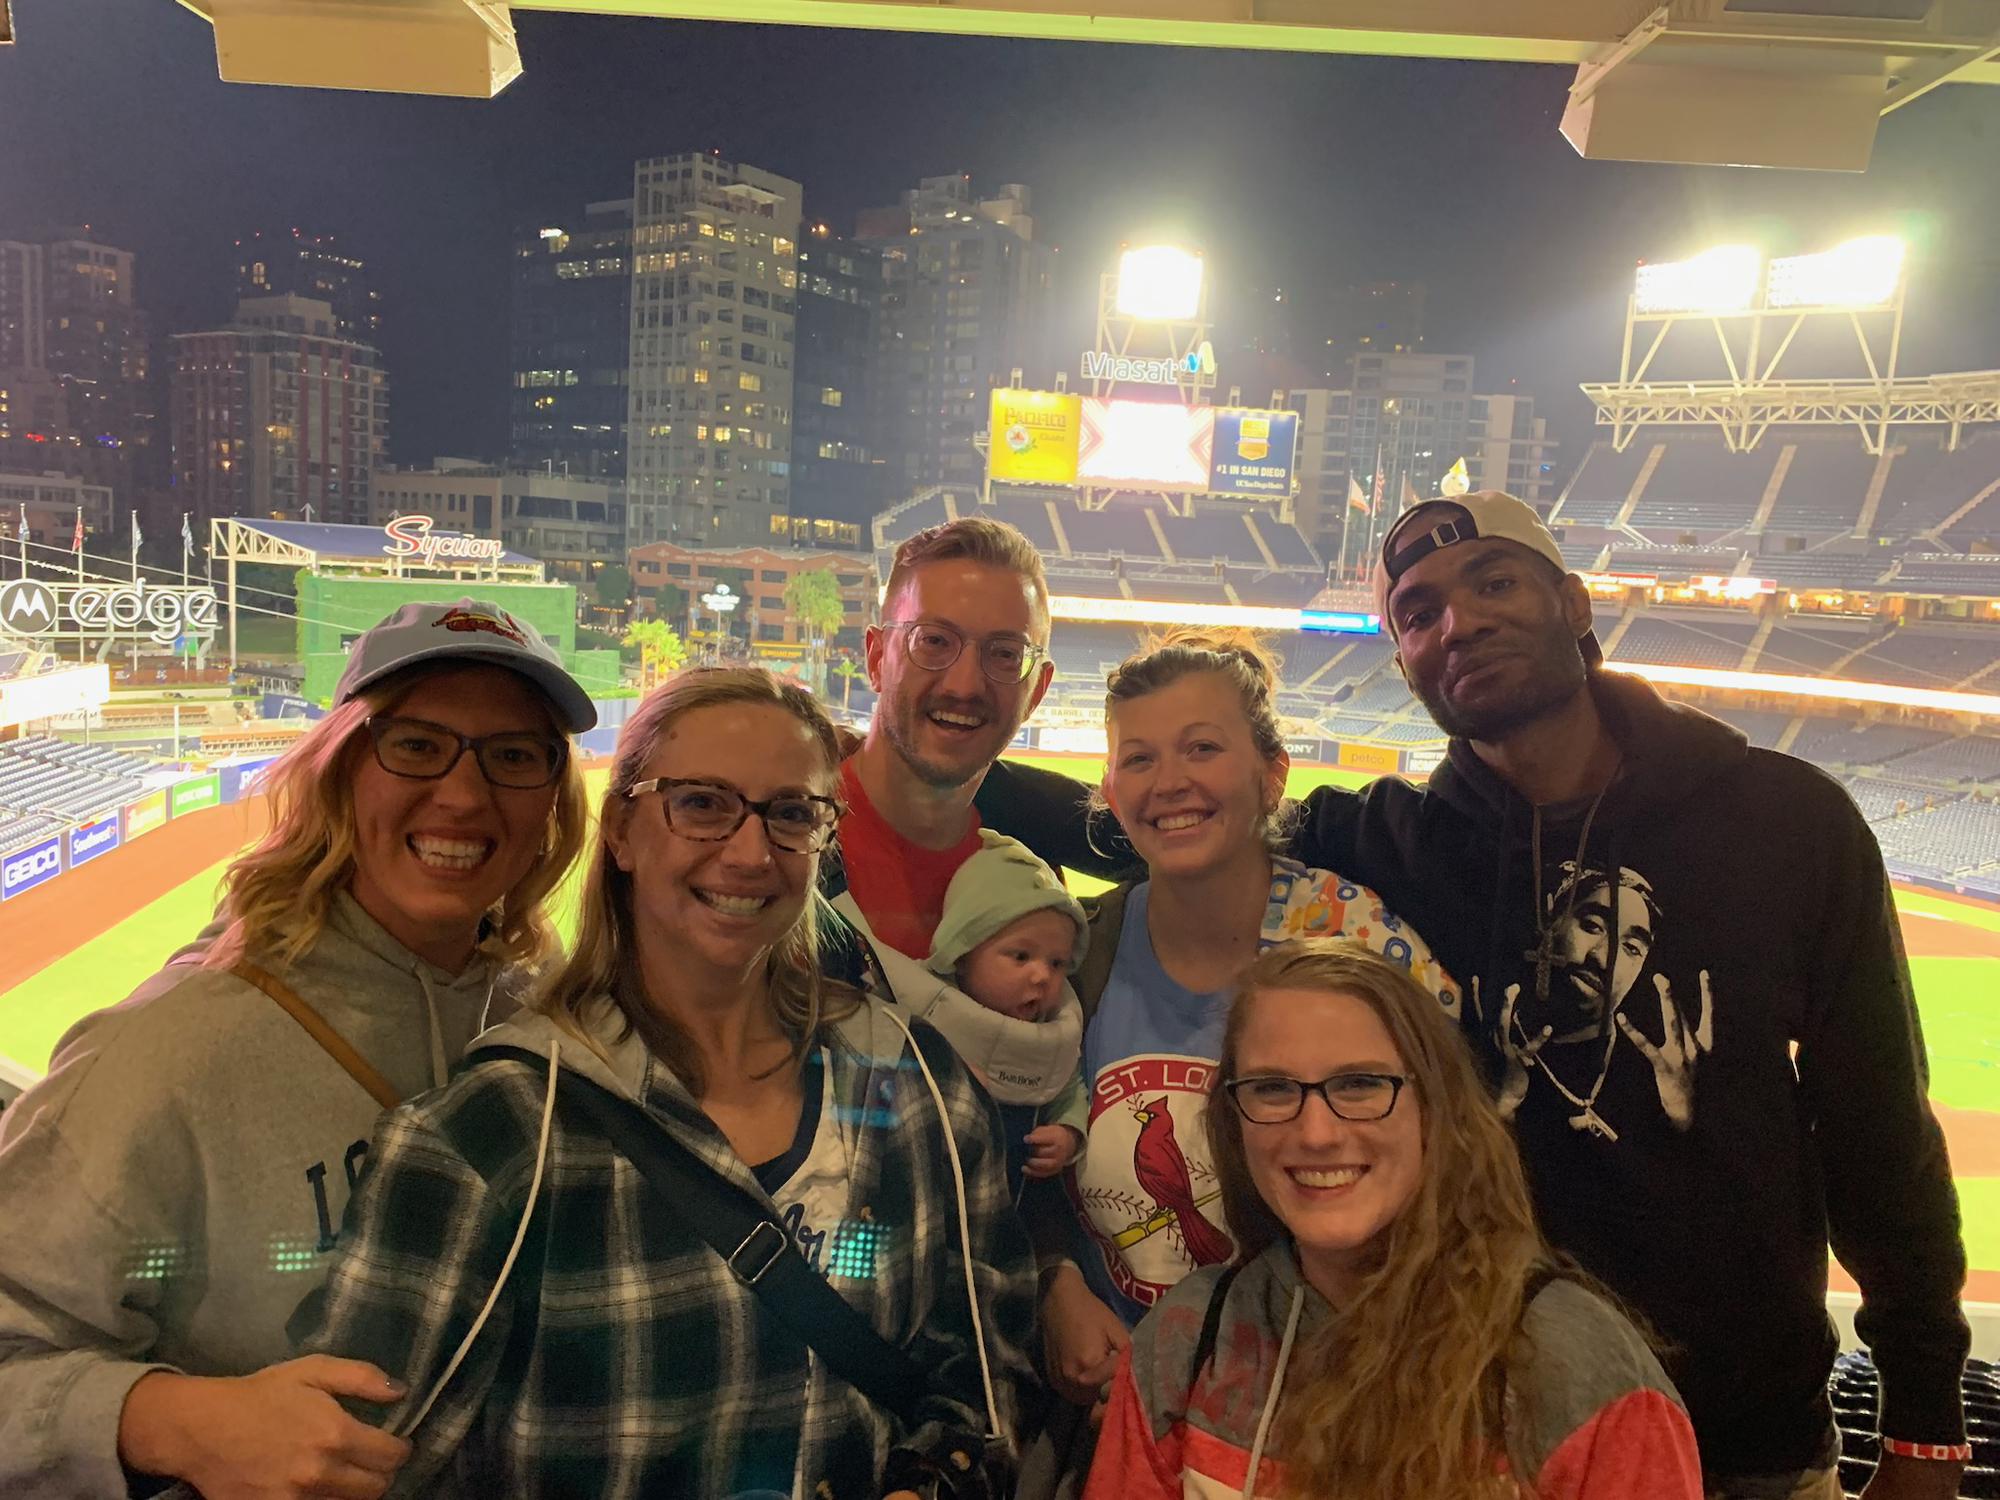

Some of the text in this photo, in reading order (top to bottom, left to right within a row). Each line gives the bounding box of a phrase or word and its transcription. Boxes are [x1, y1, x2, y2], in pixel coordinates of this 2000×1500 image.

[1086, 350, 1179, 385] Viasat
[1229, 465, 1240, 475] IN
[1241, 465, 1260, 477] SAN
[1260, 467, 1286, 479] DIEGO
[383, 515, 506, 567] Sycuan
[69, 577, 219, 645] edge
[1283, 744, 1314, 754] ONY
[1351, 752, 1385, 765] petco
[4, 843, 59, 888] GEICO
[1078, 1210, 1168, 1307] CARD
